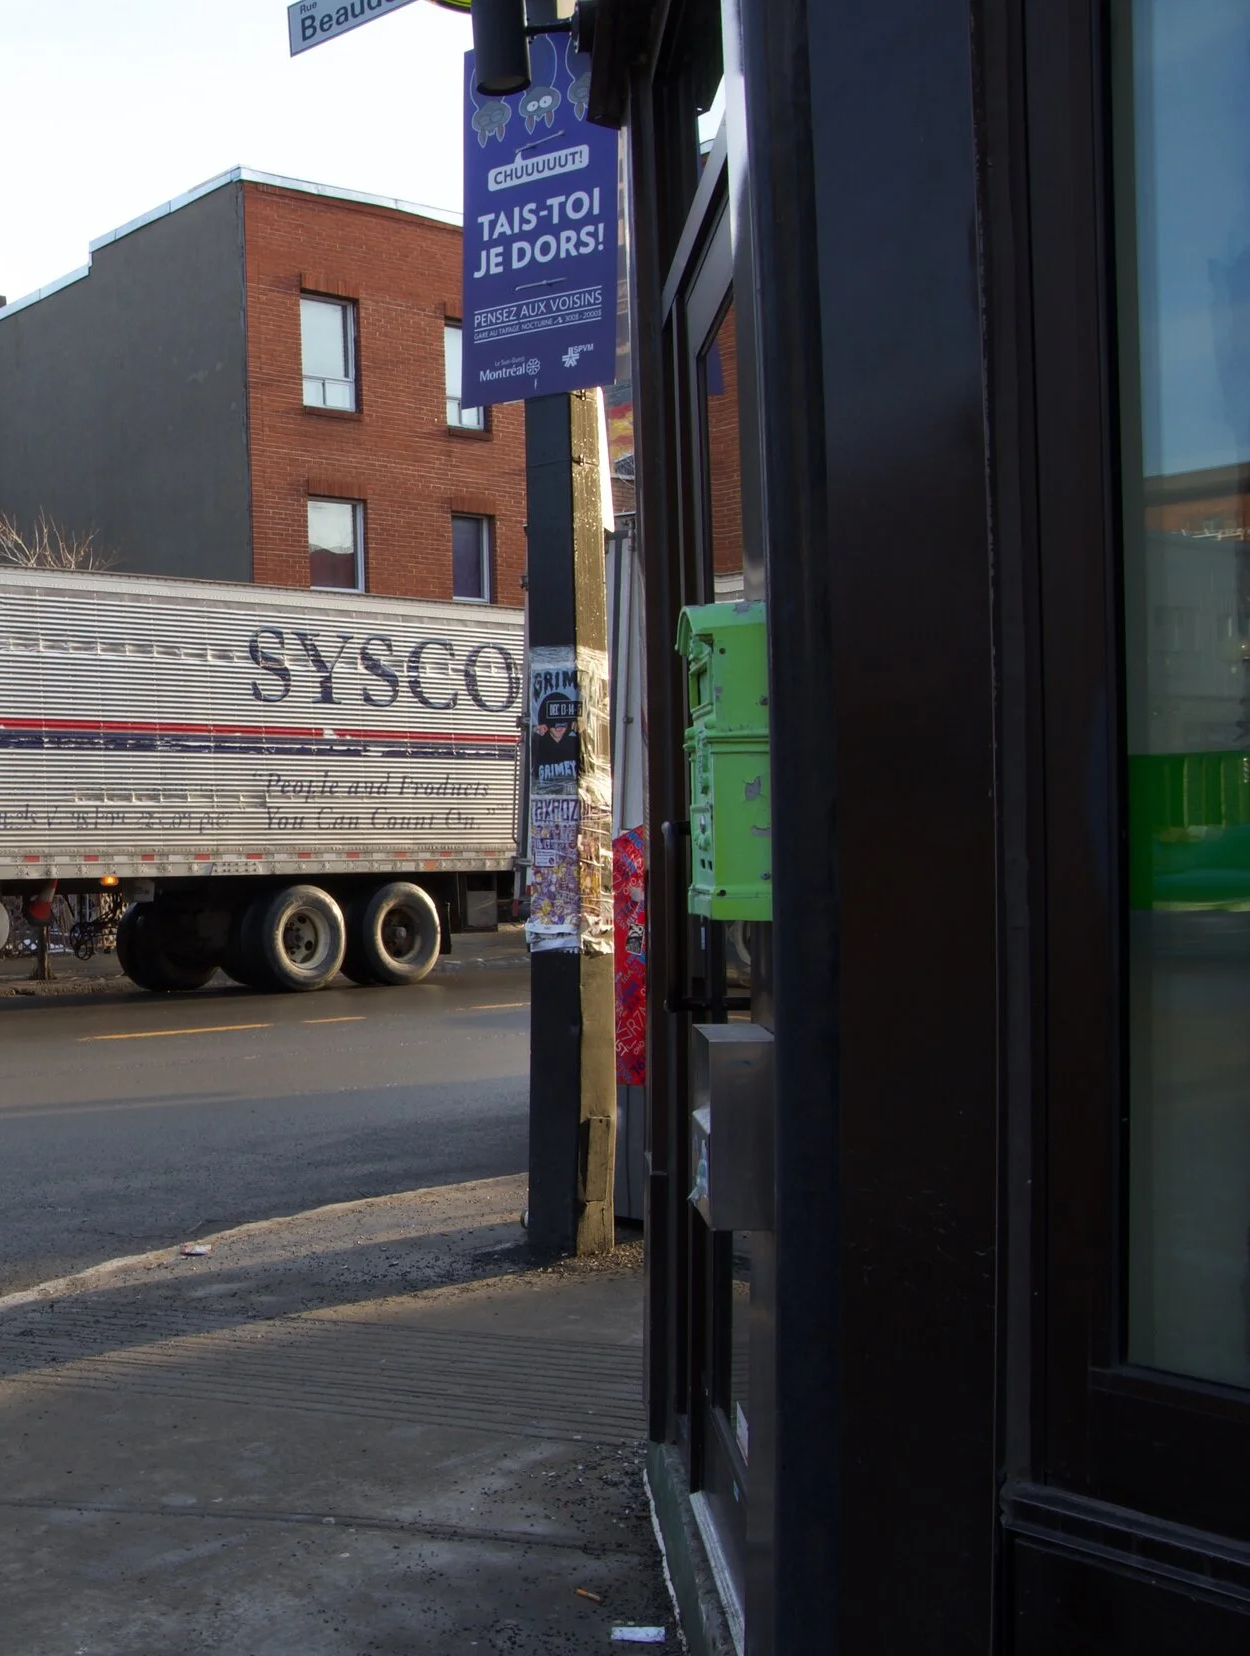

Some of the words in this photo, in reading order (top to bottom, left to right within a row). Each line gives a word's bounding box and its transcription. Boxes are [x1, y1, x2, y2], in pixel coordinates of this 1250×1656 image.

[300, 1, 317, 14] Rue
[301, 0, 394, 41] Beau
[494, 150, 583, 185] CHUUUUUT!
[477, 187, 600, 241] TAIS-TOI
[473, 246, 504, 278] JE
[512, 223, 604, 269] DORS!
[474, 307, 517, 327] PENSEZ
[520, 300, 547, 318] AUX
[550, 290, 602, 311] VOISINS
[574, 343, 594, 353] SPVM
[480, 362, 525, 382] Montréal
[249, 625, 521, 713] SYSCO
